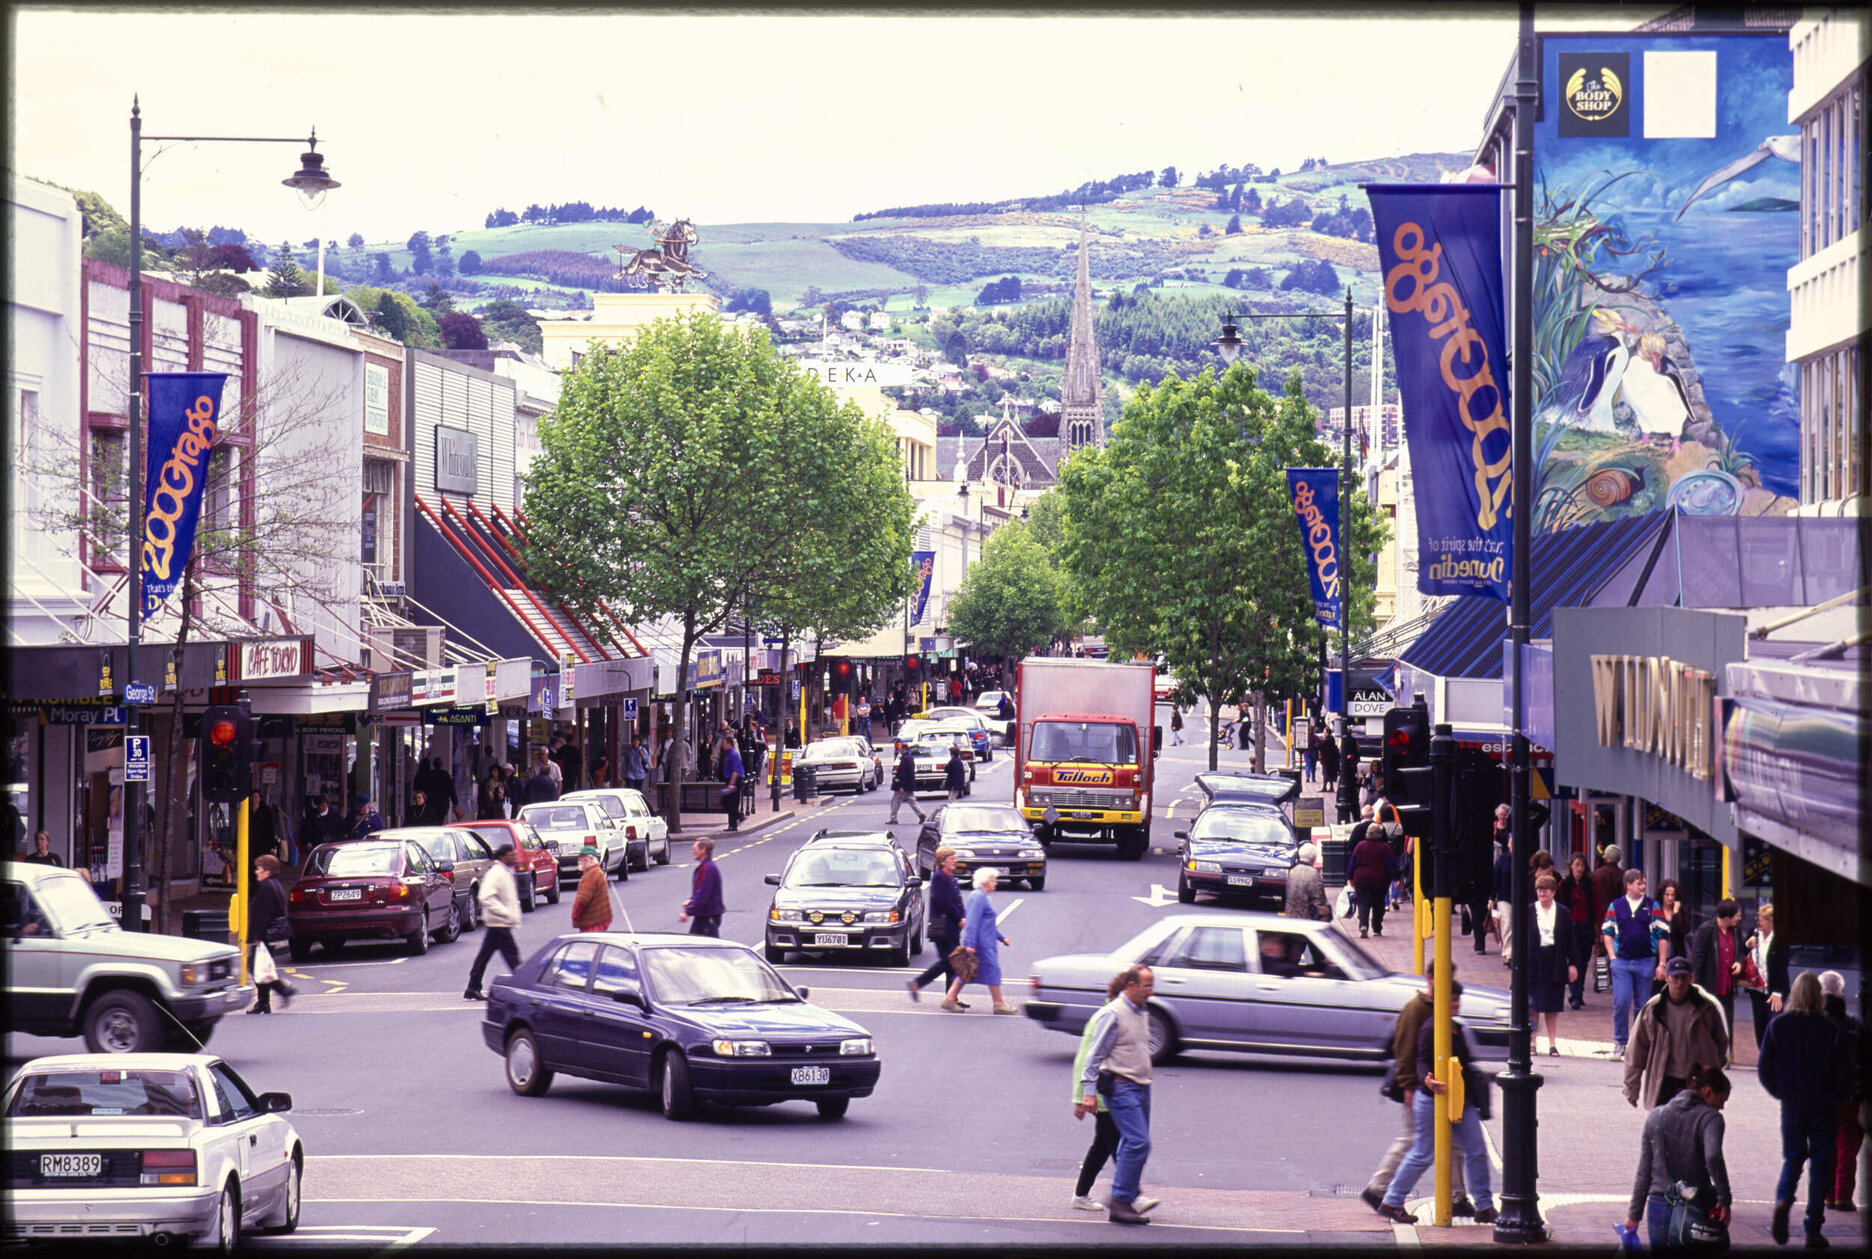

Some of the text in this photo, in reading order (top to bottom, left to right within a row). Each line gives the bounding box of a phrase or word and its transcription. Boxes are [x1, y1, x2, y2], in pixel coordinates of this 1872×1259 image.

[1575, 91, 1612, 101] BODY
[1576, 101, 1612, 111] SHOP
[126, 684, 148, 703] George
[148, 686, 155, 701] St
[1354, 691, 1387, 701] ALAN
[1354, 703, 1385, 713] DOVE
[51, 707, 120, 724] Moray Pl
[133, 738, 142, 749] P
[132, 749, 142, 758] 30
[1056, 770, 1111, 783] Tulloch
[792, 1070, 828, 1082] XB6130
[42, 1156, 100, 1172] RM8389
